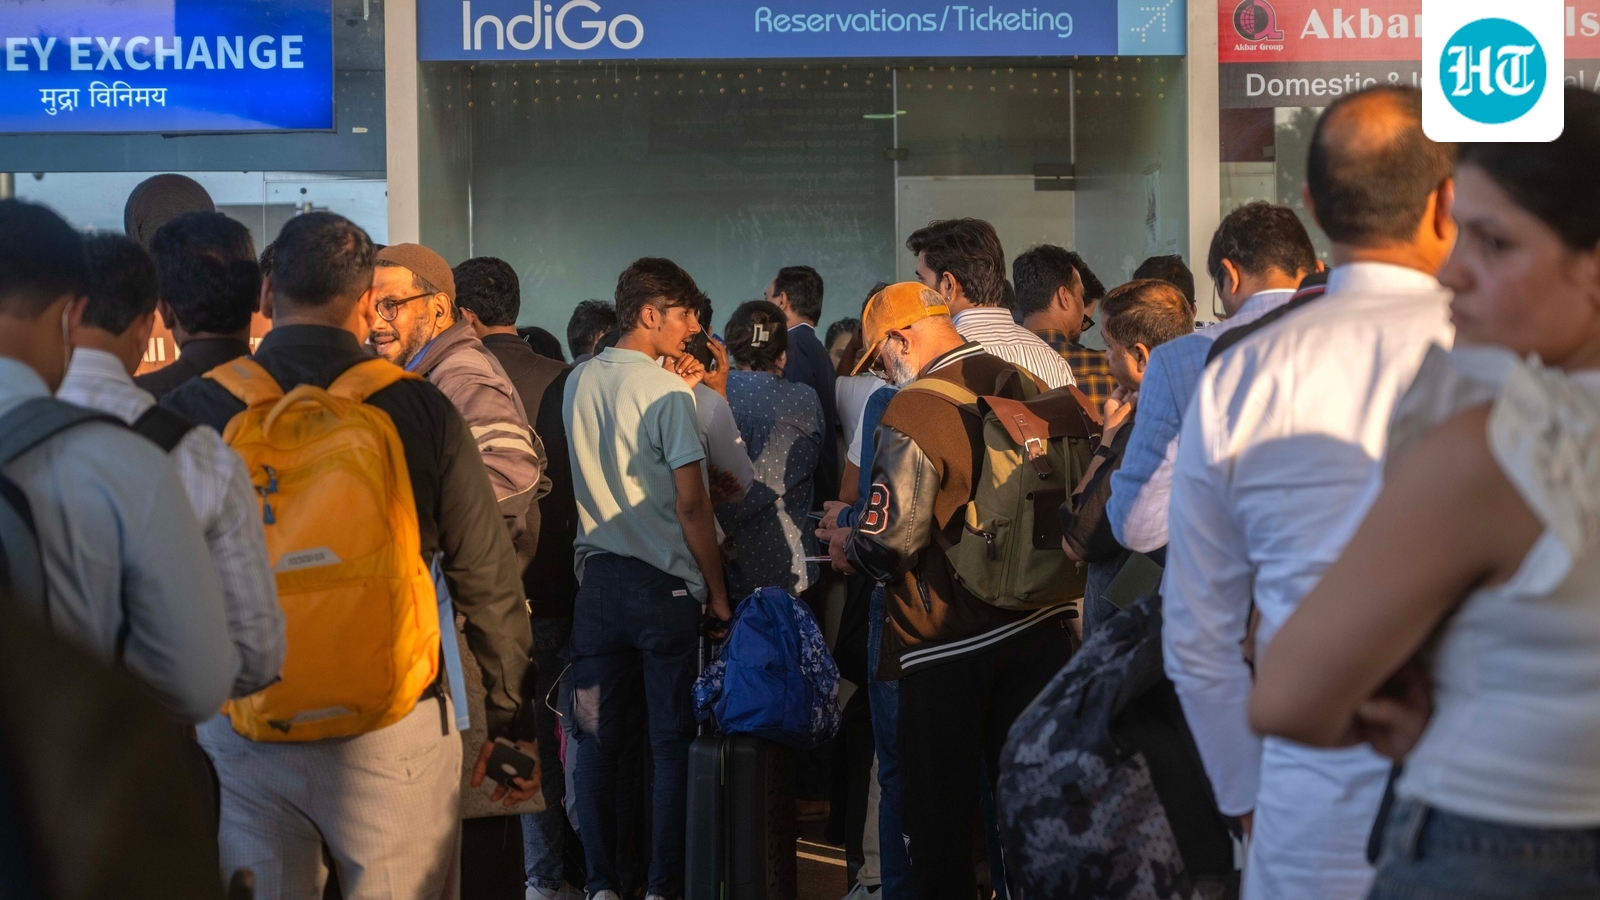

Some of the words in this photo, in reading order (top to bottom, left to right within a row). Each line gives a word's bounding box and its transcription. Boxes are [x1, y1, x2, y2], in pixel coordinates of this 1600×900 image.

[463, 0, 645, 50] IndiGo
[755, 5, 1073, 38] Reservations/Ticketing
[70, 34, 304, 71] EXCHANGE
[1259, 43, 1284, 52] Group
[39, 87, 80, 115] मुद्रा
[88, 80, 168, 108] विनिमय
[859, 483, 890, 535] B
